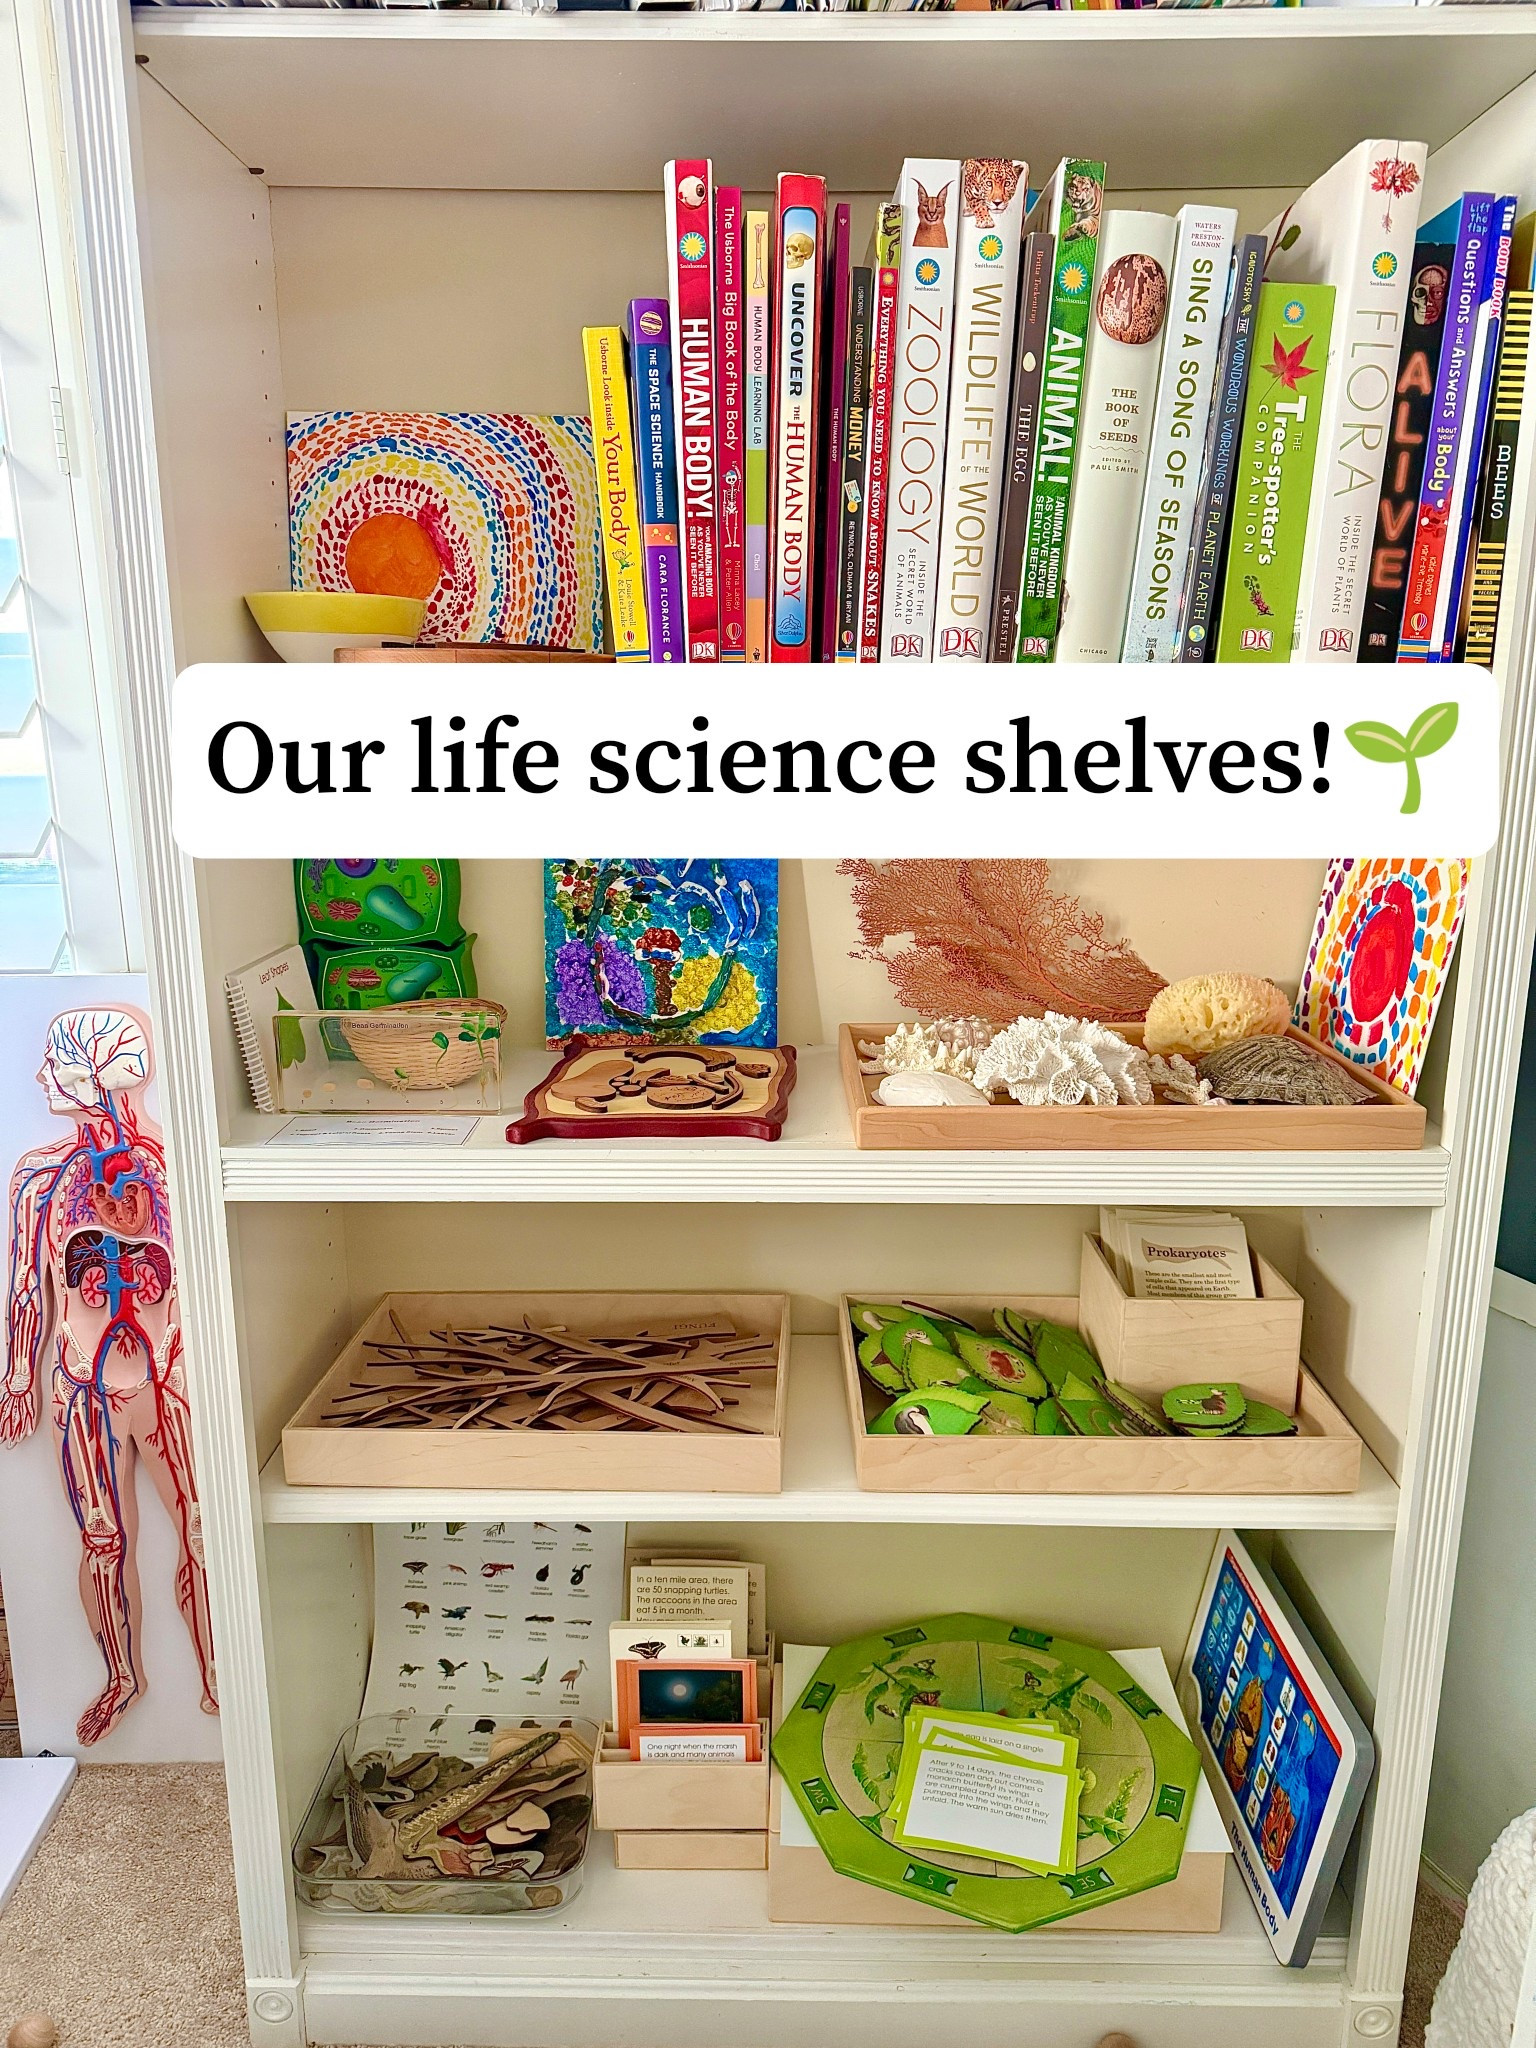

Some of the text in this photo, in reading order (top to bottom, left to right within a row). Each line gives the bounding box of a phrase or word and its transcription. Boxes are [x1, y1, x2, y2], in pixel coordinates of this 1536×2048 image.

[1467, 223, 1487, 235] flap
[1470, 204, 1490, 214] Lift
[1029, 250, 1044, 324] Britta Teckentrup
[1490, 204, 1515, 321] The BODY BOOK
[722, 207, 738, 450] The Usborne Big Book of the Body
[789, 283, 805, 396] UNCOVER
[853, 324, 864, 403] UNDERSTANDING
[1443, 239, 1481, 419] Questions and Answers
[753, 306, 762, 444] HUMAN BODY LEARNING LAB
[961, 283, 1004, 461] WILDLIFE
[1038, 327, 1083, 484] ANIMAL!
[1105, 403, 1139, 414] BOOK
[1111, 388, 1137, 399] THE
[1334, 310, 1399, 497] FLORA
[600, 338, 630, 547] Usborne Look inside Your Body
[649, 349, 665, 518] THE SPACE SCIENCE HANDBOOK
[682, 319, 713, 518] HUMAN BODY!
[848, 406, 864, 461] MONEY
[897, 303, 944, 545] ZOOLOGY
[1011, 405, 1032, 483] THE EGG
[1099, 432, 1138, 444] SEEDS
[1113, 419, 1129, 427] OF
[1146, 258, 1213, 620] SING A SONG OF SEASONS
[1193, 251, 1257, 620] IGNOTOFSKY THE WONDROUS WORKINGS OF PLANET EARTH
[1293, 431, 1303, 451] THE
[1437, 434, 1455, 442] your
[785, 421, 806, 522] HUMAN
[865, 296, 893, 637] EVERYTHING YOU NEED TO KNOW ABOUT SNAKES
[1243, 405, 1269, 554] COMPANION
[1258, 395, 1307, 565] Tree-spotter's
[1372, 351, 1432, 589] ALIVE
[1428, 444, 1453, 491] Body
[1490, 445, 1512, 520] BEES
[690, 551, 697, 560] IT
[697, 526, 704, 537] AS
[705, 543, 713, 576] AMAZING
[783, 531, 802, 603] BODY
[847, 521, 856, 559] REYNOLDS,
[951, 481, 989, 617] WORLD
[1026, 495, 1044, 597] SEEN IT BEFORE
[1036, 496, 1054, 598] AS YOU'VE NEVER
[1046, 501, 1065, 598] ANIMAL KINGDOM
[1331, 515, 1351, 614] WORLD OF PLANTS
[1342, 515, 1362, 615] INSIDE THE SECRET
[658, 554, 671, 643] CARA FLORANCE
[705, 578, 713, 597] BODY
[845, 600, 853, 624] BRYAN
[846, 561, 854, 593] OLDHAM
[894, 554, 905, 618] OF ANIMALS
[905, 548, 916, 625] SECRET WORLD
[916, 561, 927, 617] INSIDE THE
[259, 961, 290, 984] Leaf Shapes
[1147, 1246, 1226, 1260] Prokaryotes
[1014, 1775, 1044, 1785] chrysalis
[1231, 1821, 1278, 1935] The Human Body
